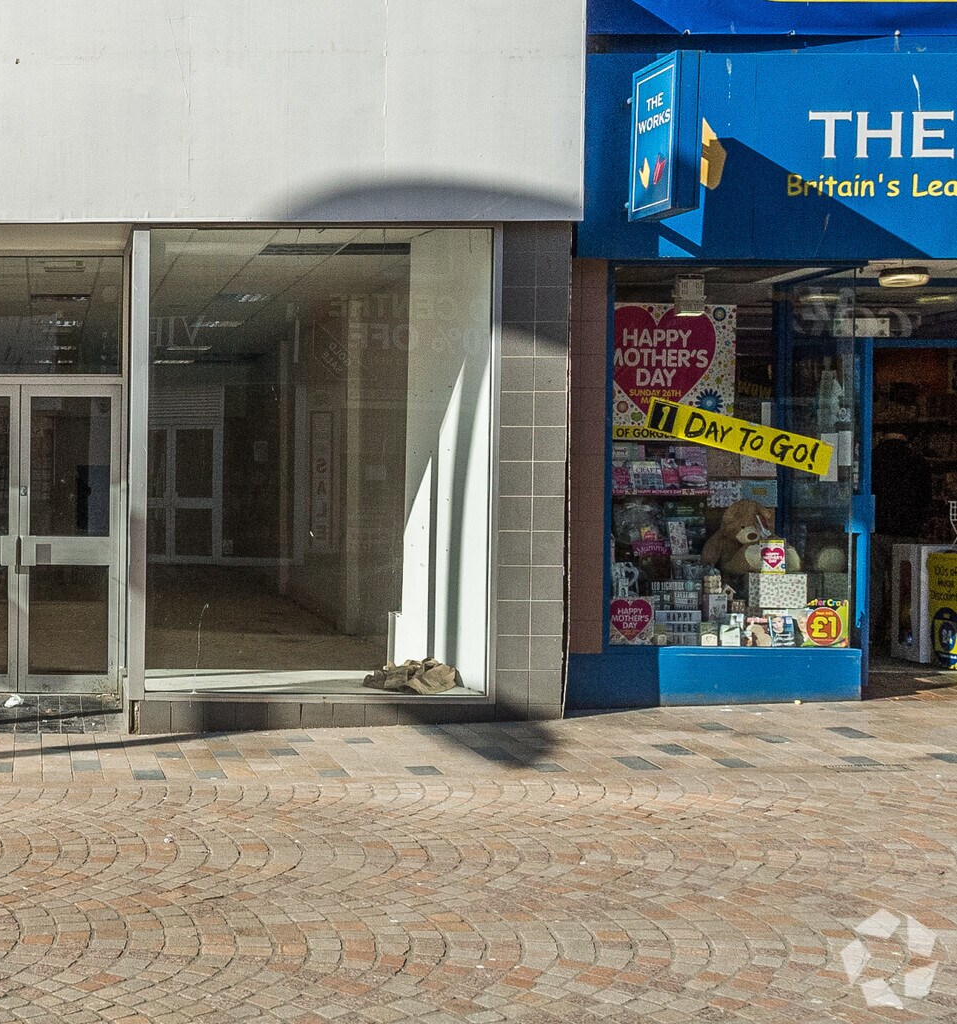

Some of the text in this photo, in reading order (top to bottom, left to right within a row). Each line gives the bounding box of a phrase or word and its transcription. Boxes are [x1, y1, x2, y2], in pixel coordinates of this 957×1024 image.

[646, 92, 665, 111] THE
[638, 108, 671, 135] WORKS
[808, 110, 955, 159] THE
[786, 173, 901, 197] Britain's
[622, 328, 692, 348] HAPPY
[614, 347, 709, 369] MOTHER'S
[635, 368, 677, 387] DAY
[629, 388, 682, 397] SUNDAY 26TH
[616, 428, 631, 438] OF
[657, 405, 671, 430] 1
[684, 411, 732, 443] DAY
[611, 614, 649, 622] MOTHER'S
[617, 607, 643, 615] HAPPY
[622, 621, 638, 629] DAY
[810, 616, 837, 638] £1
